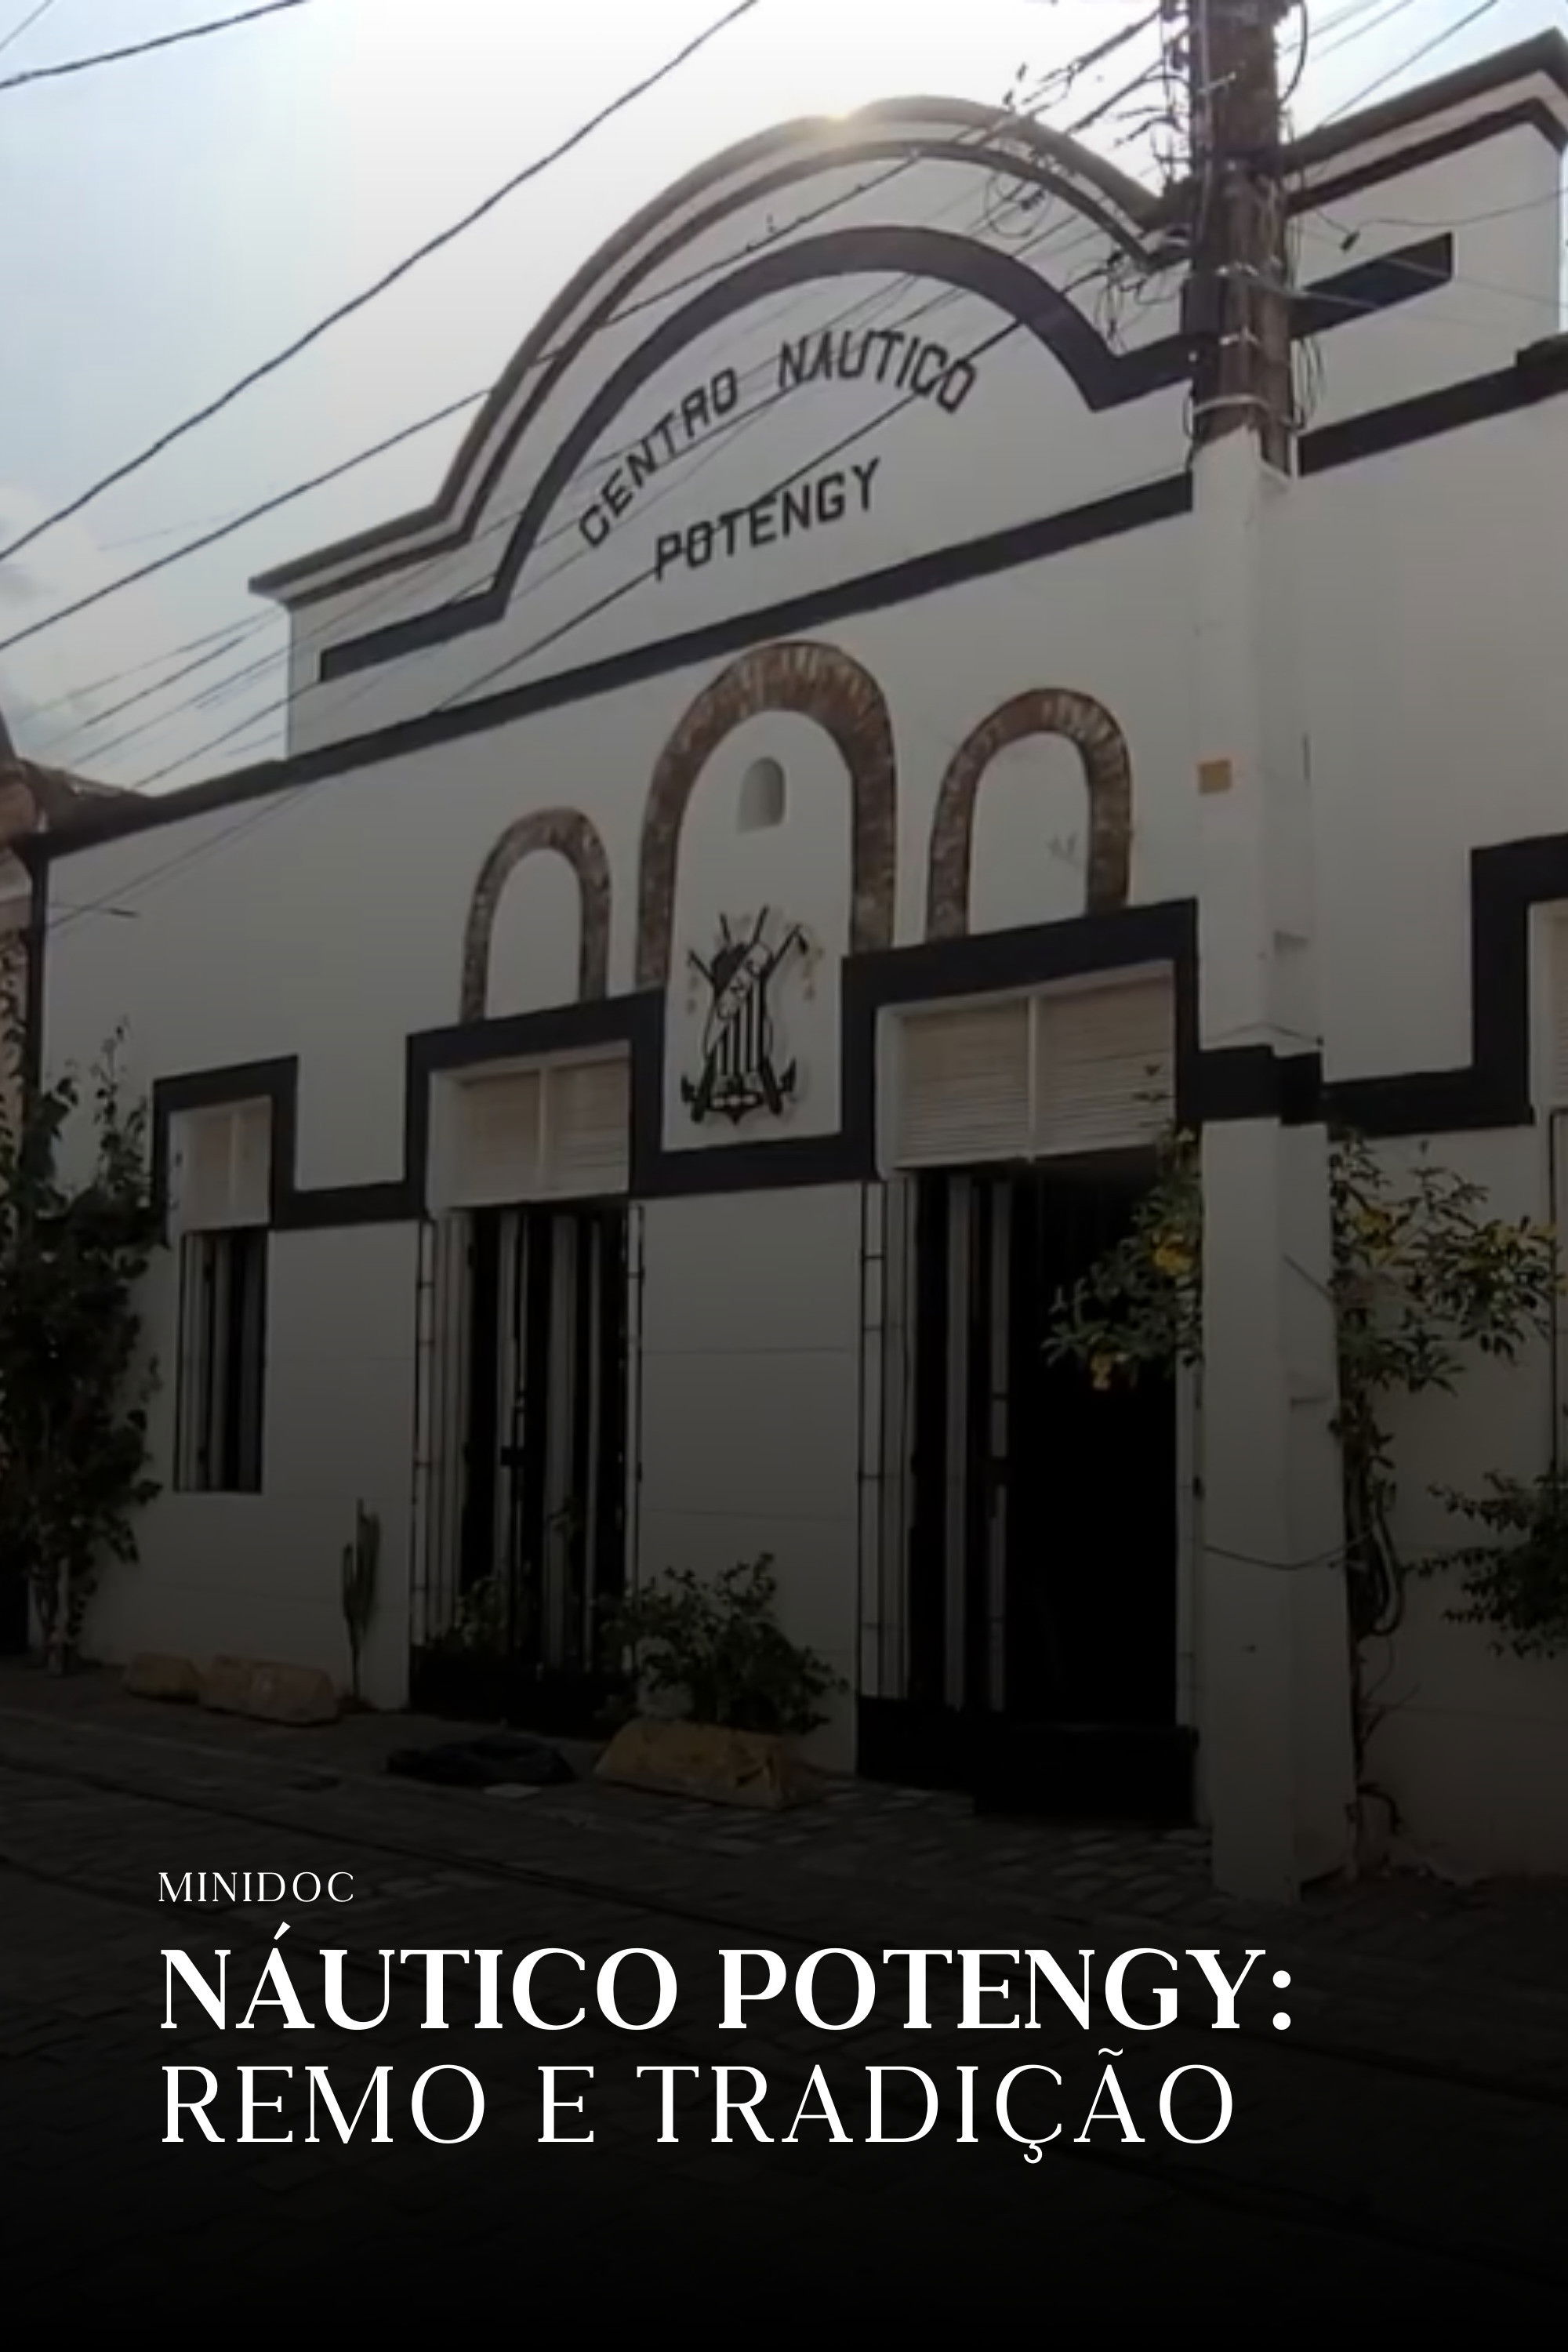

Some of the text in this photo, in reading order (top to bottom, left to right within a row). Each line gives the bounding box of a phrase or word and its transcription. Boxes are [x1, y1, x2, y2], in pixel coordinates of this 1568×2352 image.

[578, 329, 977, 547] CENTRO NAUTICO
[655, 457, 880, 582] POTENGY
